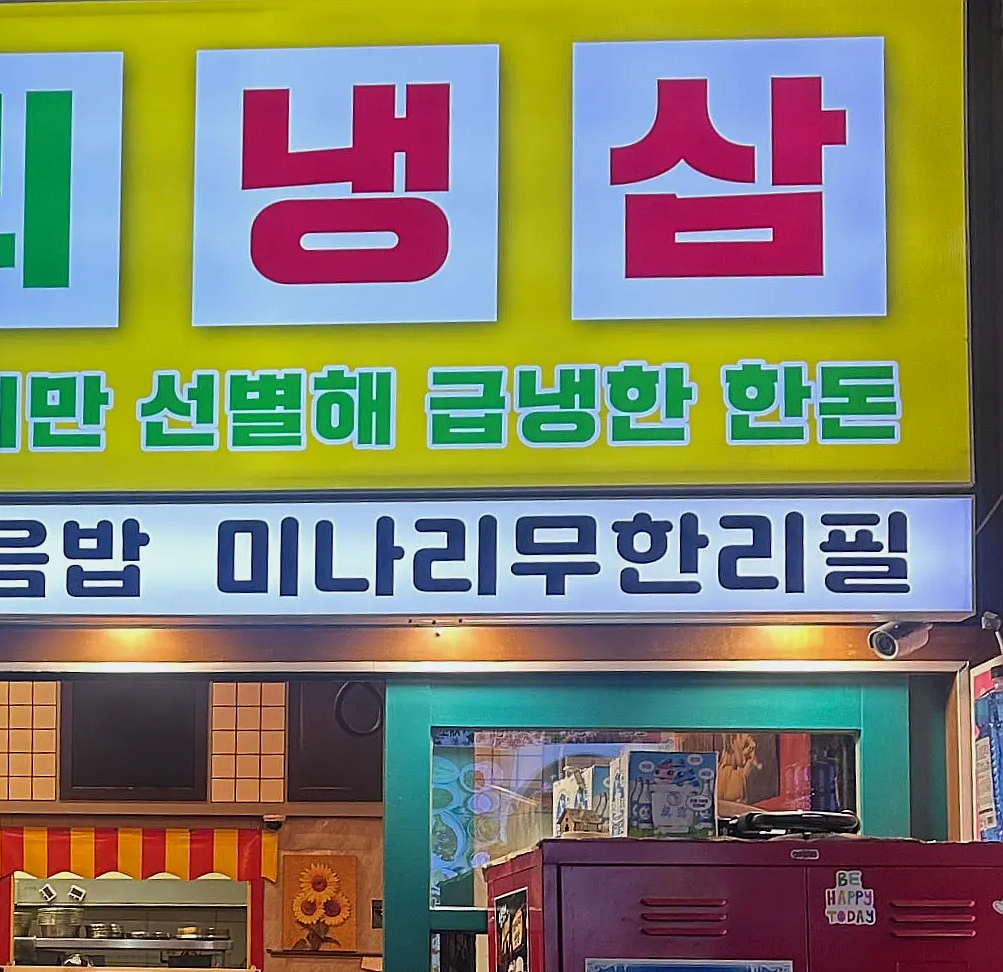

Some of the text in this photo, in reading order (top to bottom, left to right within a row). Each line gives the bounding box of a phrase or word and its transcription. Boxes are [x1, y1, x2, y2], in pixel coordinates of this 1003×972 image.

[136, 366, 397, 451] 선별해
[427, 361, 696, 449] 급냉한
[720, 359, 902, 446] 한돈
[215, 511, 912, 597] 미나리무한리필
[837, 872, 861, 886] BE
[826, 889, 874, 906] HAPPY
[826, 910, 875, 924] TODAY
